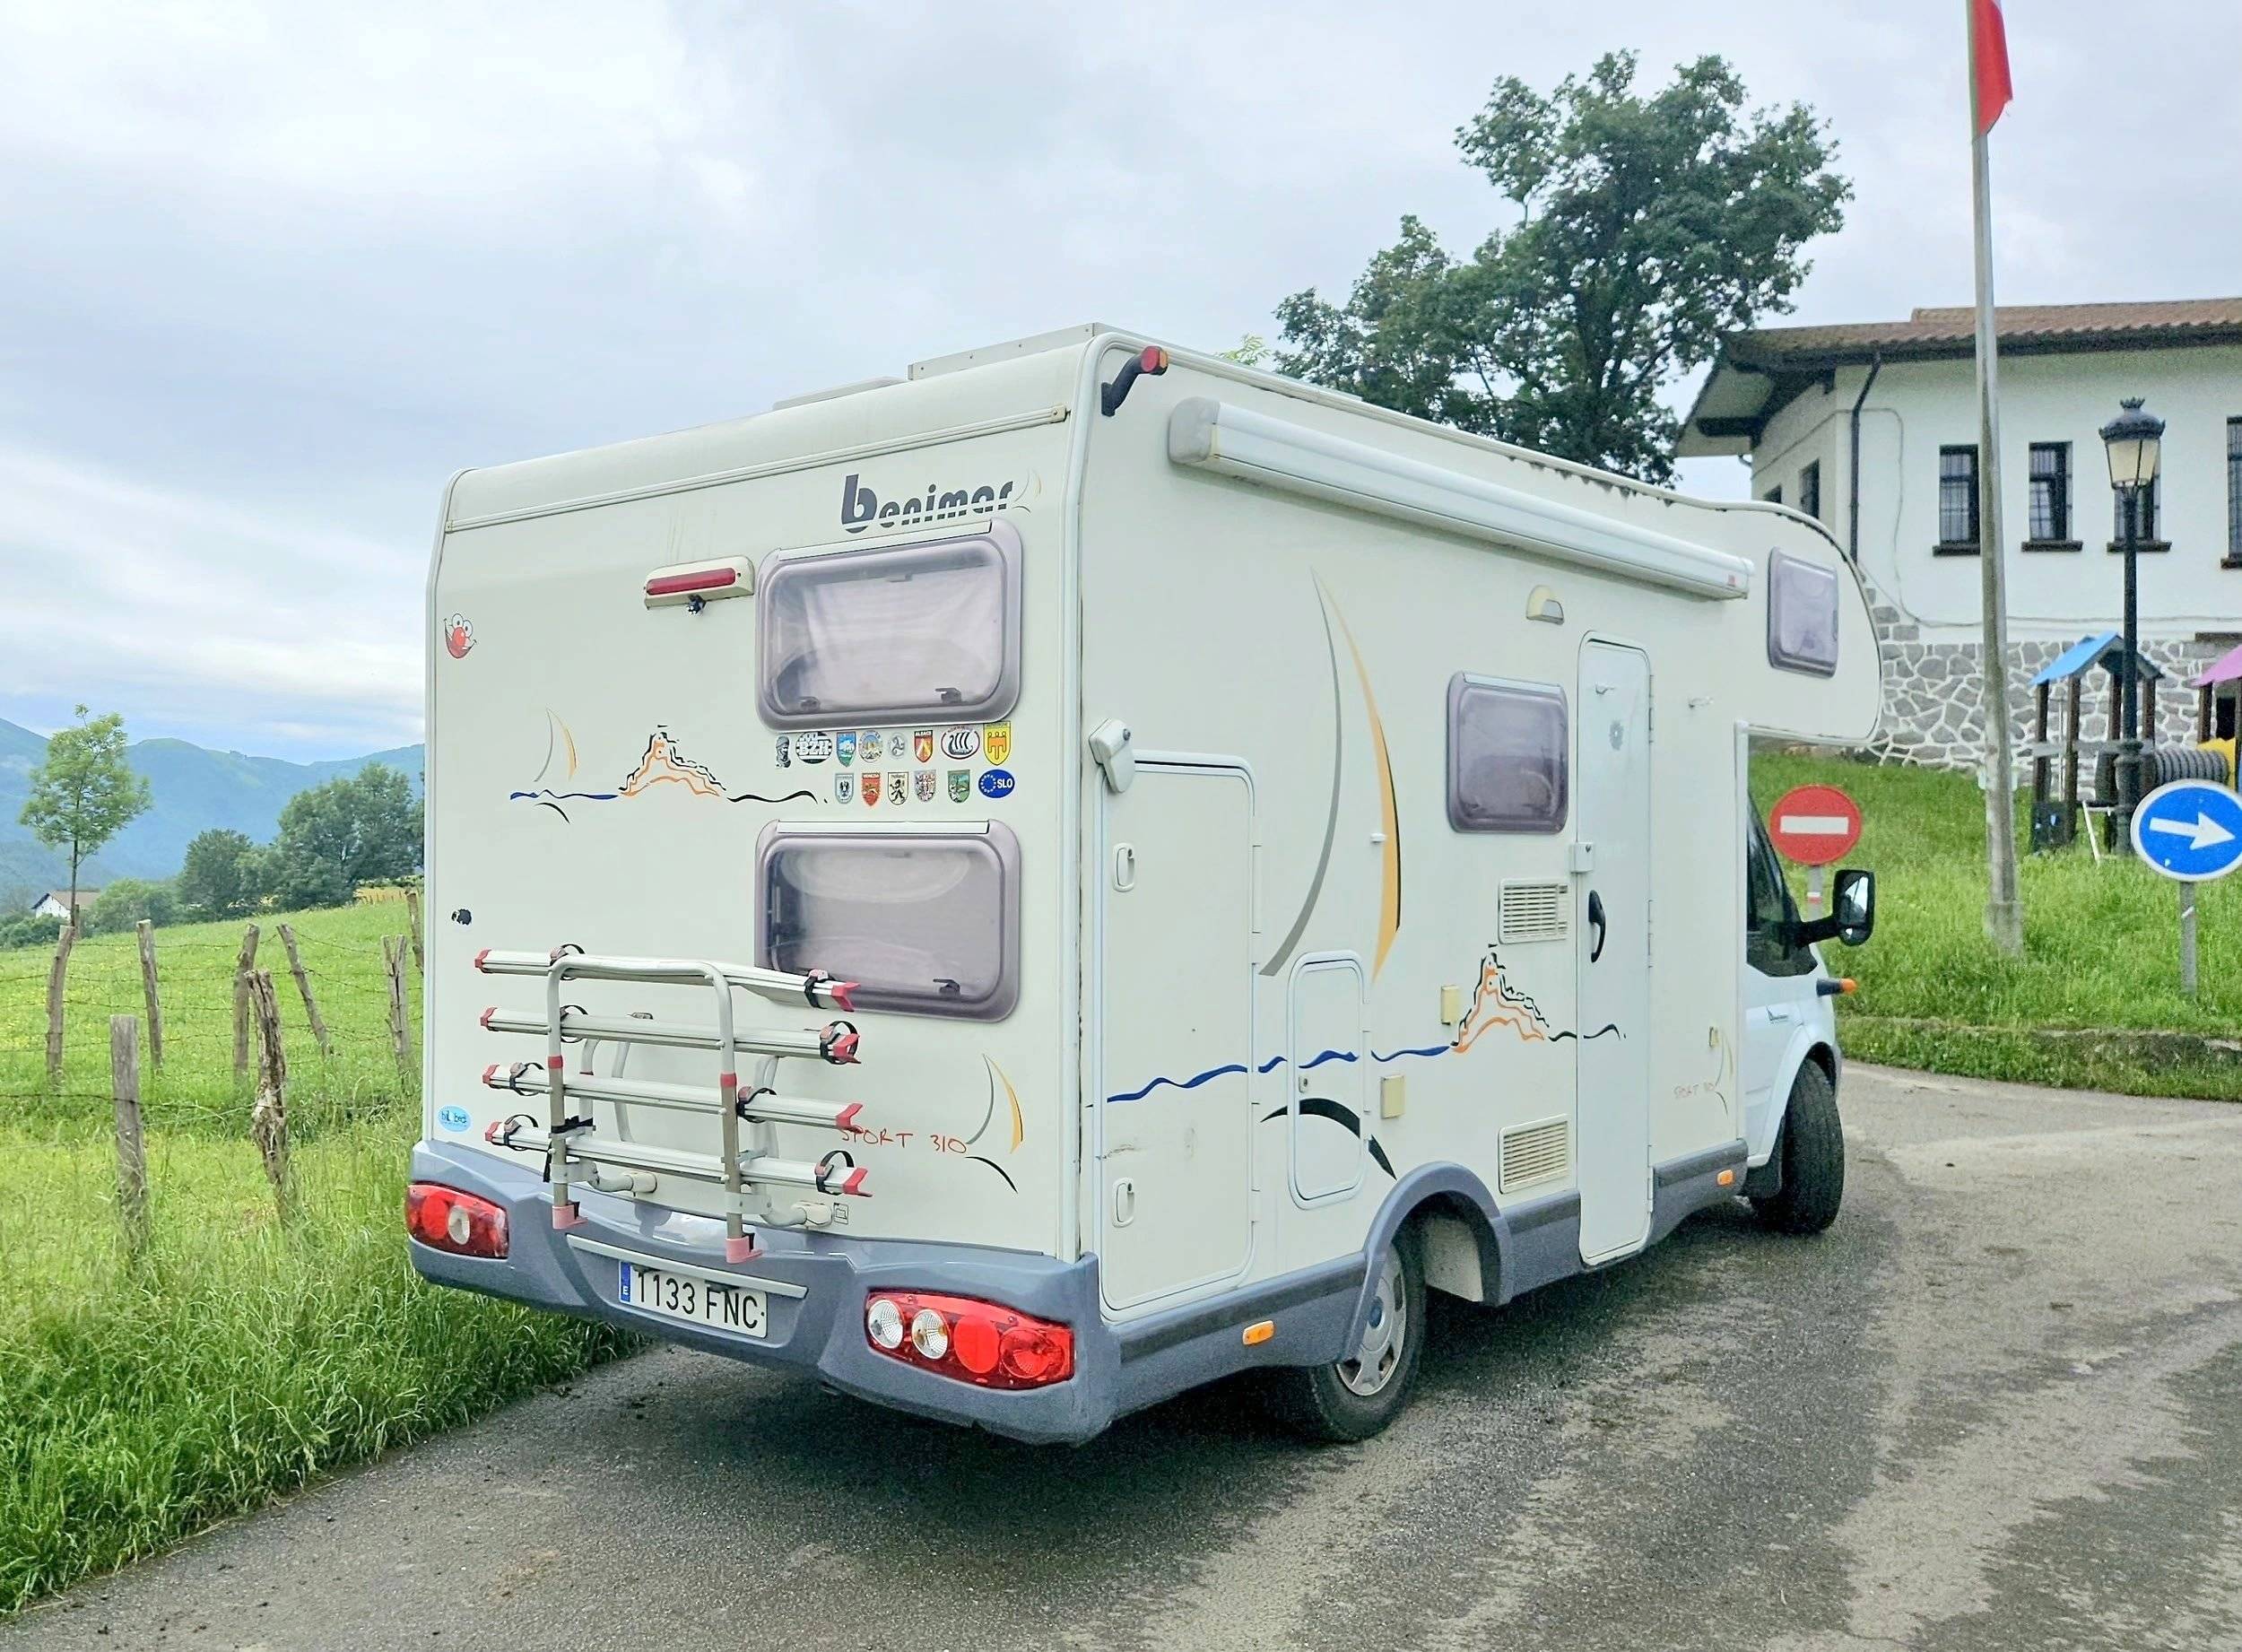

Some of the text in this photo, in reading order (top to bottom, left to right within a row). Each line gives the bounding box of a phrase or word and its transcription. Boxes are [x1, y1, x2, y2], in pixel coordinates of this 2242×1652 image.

[841, 474, 1013, 534] benimar
[996, 778, 1013, 788] SLO
[930, 1135, 968, 1154] 310
[621, 1284, 629, 1296] E
[638, 1273, 759, 1329] 1133 FNC
